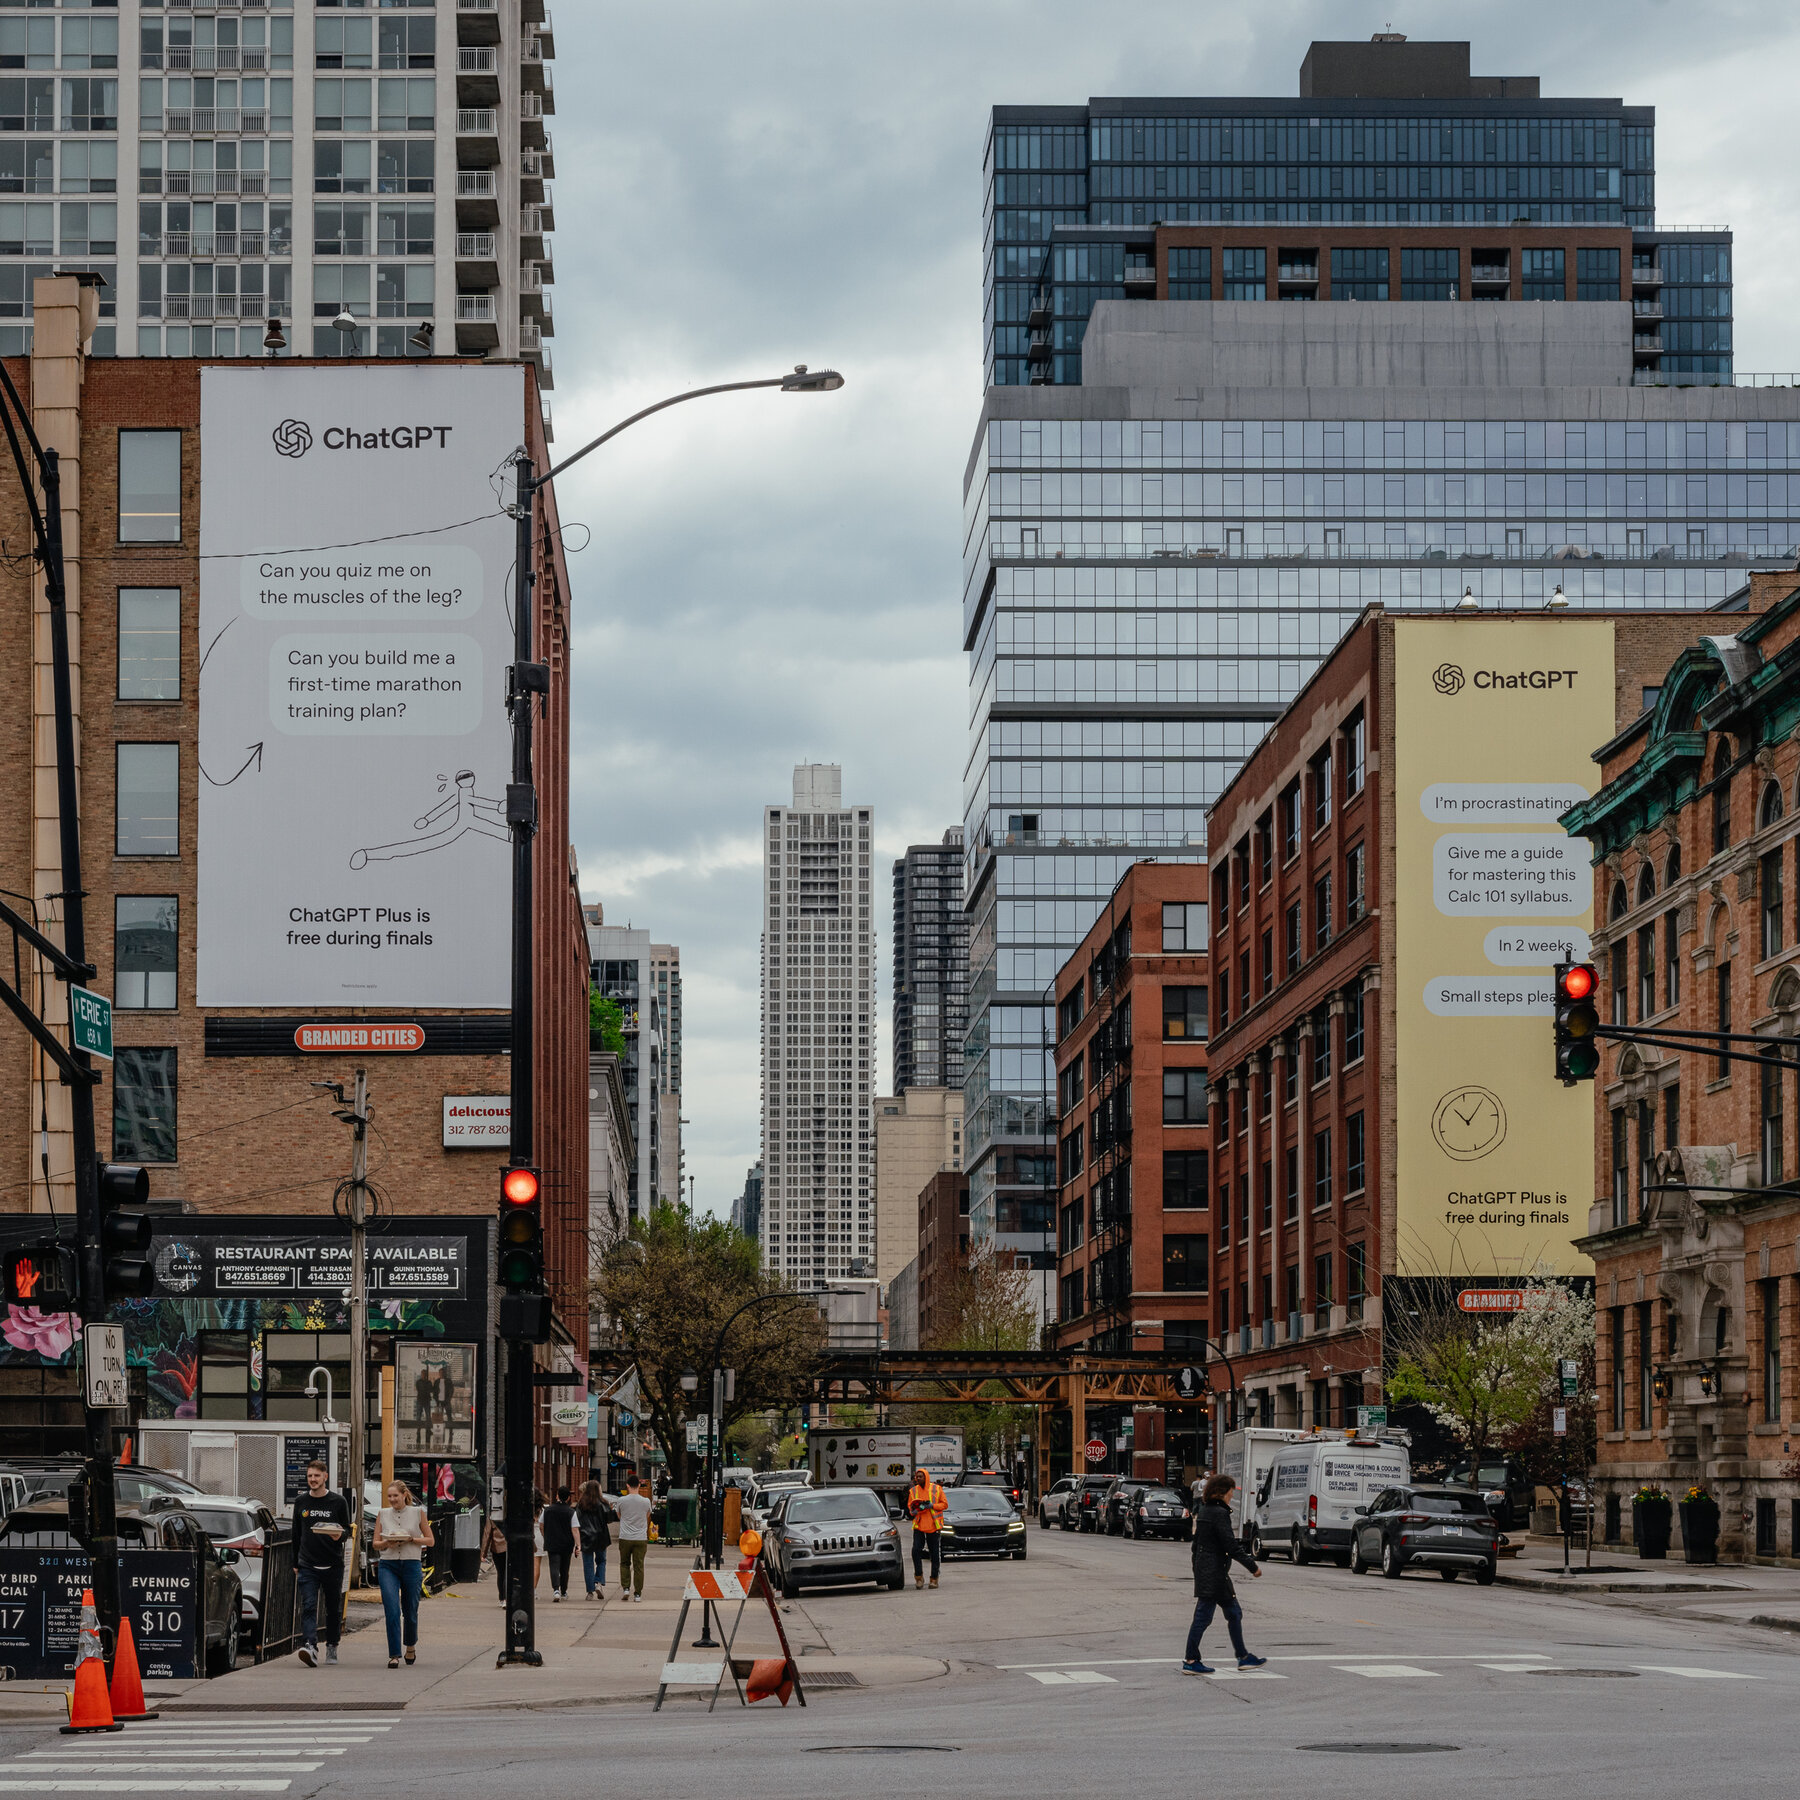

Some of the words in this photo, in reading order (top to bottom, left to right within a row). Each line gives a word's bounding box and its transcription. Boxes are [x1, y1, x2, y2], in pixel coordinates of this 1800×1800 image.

[323, 426, 452, 450] ChatGPT
[260, 563, 294, 577] Can
[300, 567, 331, 581] you
[337, 563, 372, 581] quiz
[378, 566, 405, 577] me
[410, 566, 431, 577] on
[260, 590, 289, 603] the
[294, 589, 364, 603] muscles
[370, 589, 388, 603] of
[393, 589, 421, 603] the
[427, 589, 462, 607] leg?
[288, 651, 323, 665] Can
[328, 654, 359, 668] you
[365, 650, 407, 665] build
[413, 654, 440, 665] me
[446, 654, 455, 665] a
[288, 677, 371, 691] first-time
[377, 677, 462, 691] marathon
[1474, 670, 1578, 690] ChatGPT
[288, 704, 354, 721] training
[361, 703, 407, 721] plan?
[1448, 847, 1480, 859] Give
[1485, 850, 1507, 859] me
[1511, 850, 1519, 859] a
[1524, 847, 1564, 863] guide
[1448, 869, 1468, 881] for
[1473, 869, 1545, 885] mastering
[1550, 869, 1576, 881] this
[1448, 890, 1481, 902] Calc
[1485, 890, 1506, 902] 101
[1511, 890, 1573, 906] syllabus.
[289, 908, 371, 922] ChatGPT
[376, 908, 412, 922] Plus
[417, 908, 431, 922] is
[286, 931, 321, 945] free
[326, 931, 381, 949] during
[386, 931, 433, 945] finals
[1499, 940, 1512, 952] In
[1516, 939, 1525, 952] 2
[1528, 939, 1577, 952] weeks.
[1441, 990, 1481, 1003] Small
[1485, 991, 1523, 1005] steps
[1528, 990, 1556, 1005] plea
[80, 996, 102, 1027] ERIE
[103, 1010, 109, 1026] ST
[302, 1030, 368, 1046] BRANDED
[371, 1029, 417, 1046] CITIES
[449, 1106, 512, 1117] delicious
[448, 1126, 465, 1135] 312
[467, 1125, 487, 1135] 787
[488, 1125, 511, 1135] 820
[1447, 1192, 1517, 1205] ChatGPT
[1520, 1191, 1551, 1205] Plus
[1555, 1192, 1567, 1205] is
[1445, 1211, 1475, 1224] free
[1479, 1211, 1525, 1226] during
[1529, 1211, 1569, 1224] finals
[215, 1247, 316, 1260] RESTAURANT
[373, 1247, 458, 1260] AVAILABLE
[225, 1273, 286, 1281] 847.651.8669
[389, 1273, 449, 1281] 847.651.5589
[1464, 1294, 1520, 1307] BRANDED
[105, 1334, 116, 1349] NO
[103, 1357, 121, 1372] TURN
[96, 1380, 110, 1395] ON
[557, 1410, 582, 1419] GREENS
[1086, 1446, 1105, 1455] STOP
[310, 1510, 330, 1518] SPINS
[11, 1574, 38, 1583] BIRD
[58, 1575, 92, 1585] PARKI
[132, 1577, 191, 1588] EVENING
[145, 1592, 177, 1602] RATE
[140, 1610, 182, 1635] $10
[147, 1669, 173, 1677] parking
